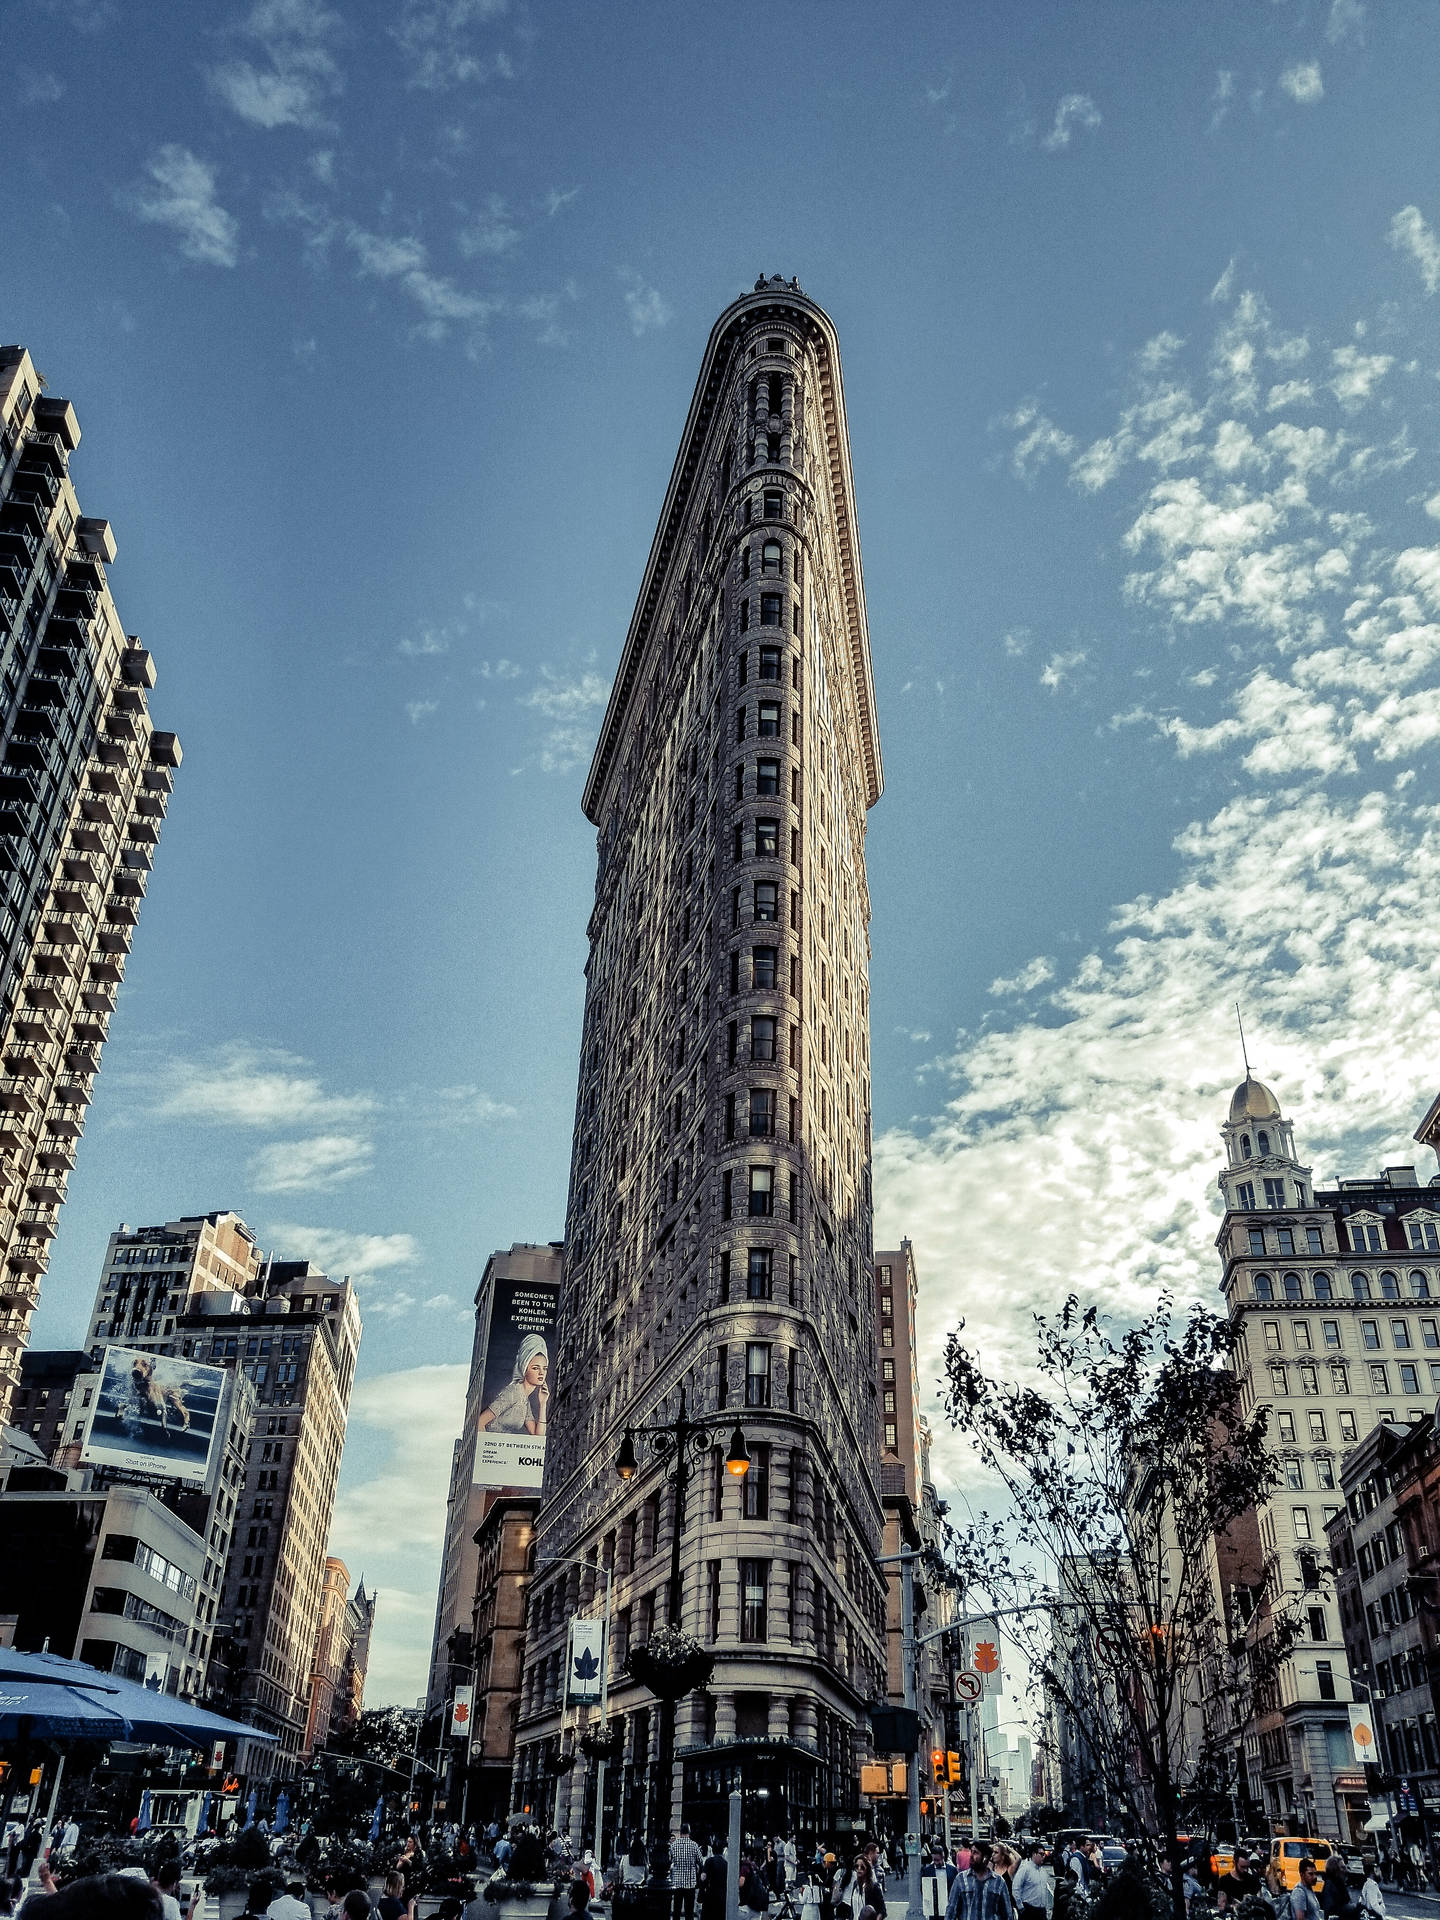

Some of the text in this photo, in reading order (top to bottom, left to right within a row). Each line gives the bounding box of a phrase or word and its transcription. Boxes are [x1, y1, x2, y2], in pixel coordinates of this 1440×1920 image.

[514, 1292, 554, 1300] SOMEONE'S
[511, 1315, 554, 1324] EXPERIENCE
[518, 1324, 544, 1332] CENTER
[126, 1458, 138, 1466] Shot
[148, 1462, 166, 1470] iPhone
